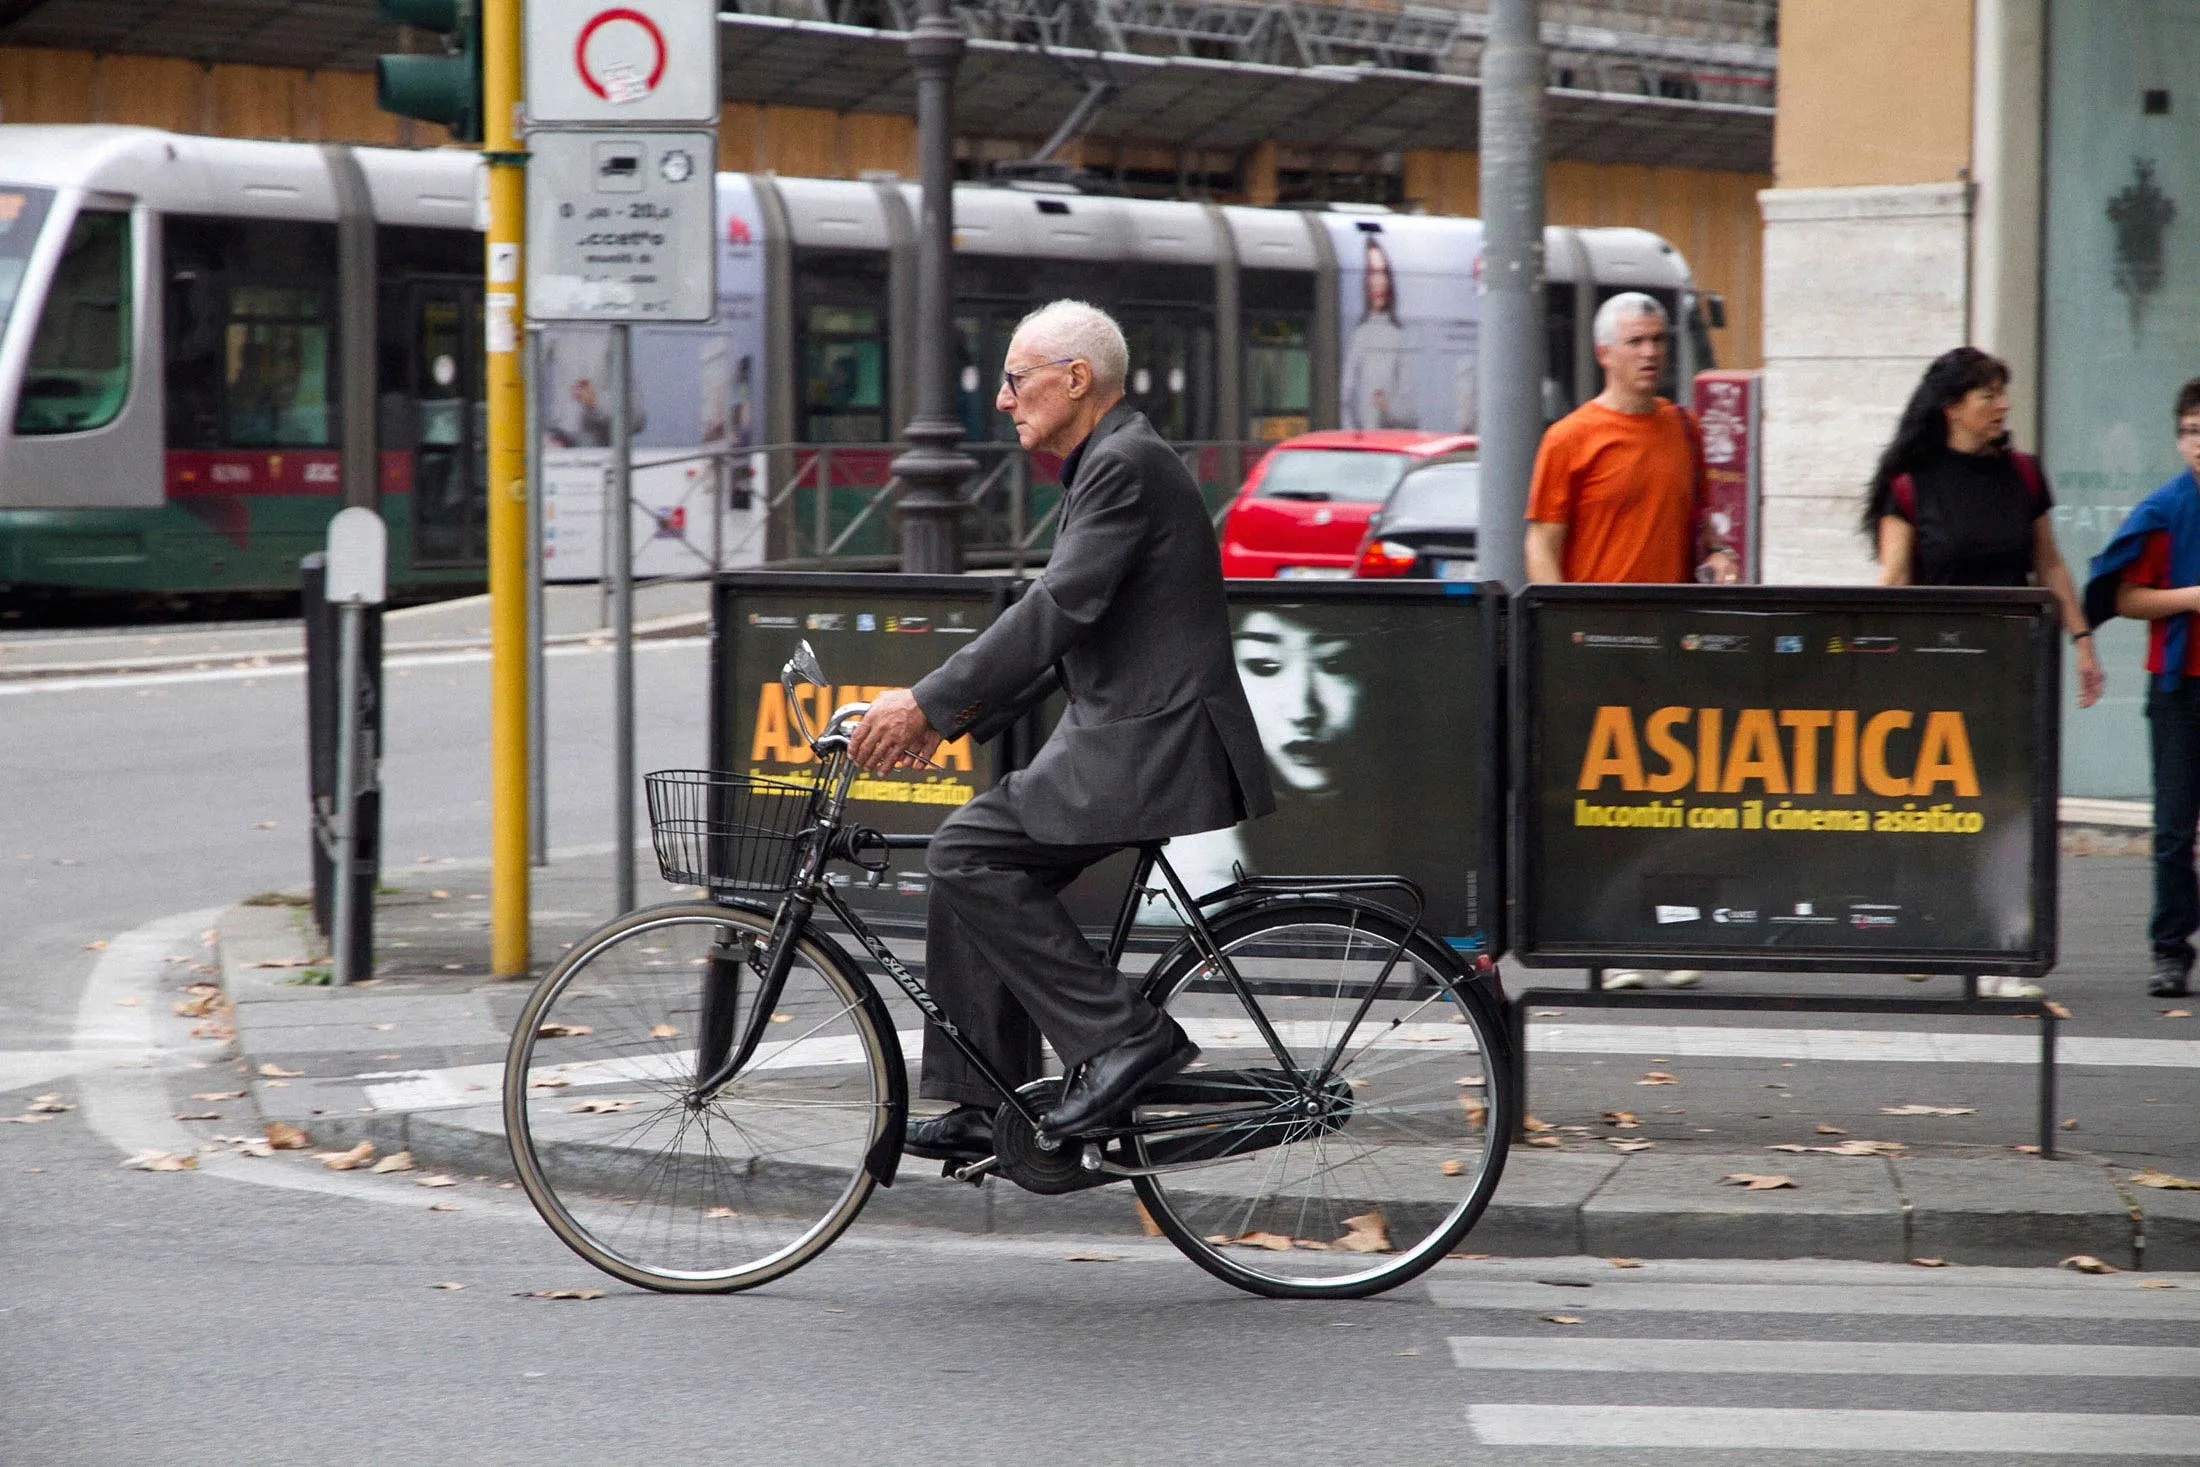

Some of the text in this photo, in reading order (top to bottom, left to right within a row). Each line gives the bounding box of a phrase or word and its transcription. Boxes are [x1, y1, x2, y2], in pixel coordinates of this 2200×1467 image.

[1577, 705, 1982, 797] ASIATICA
[1574, 799, 1984, 833] Incontri con il cinema asiatico
